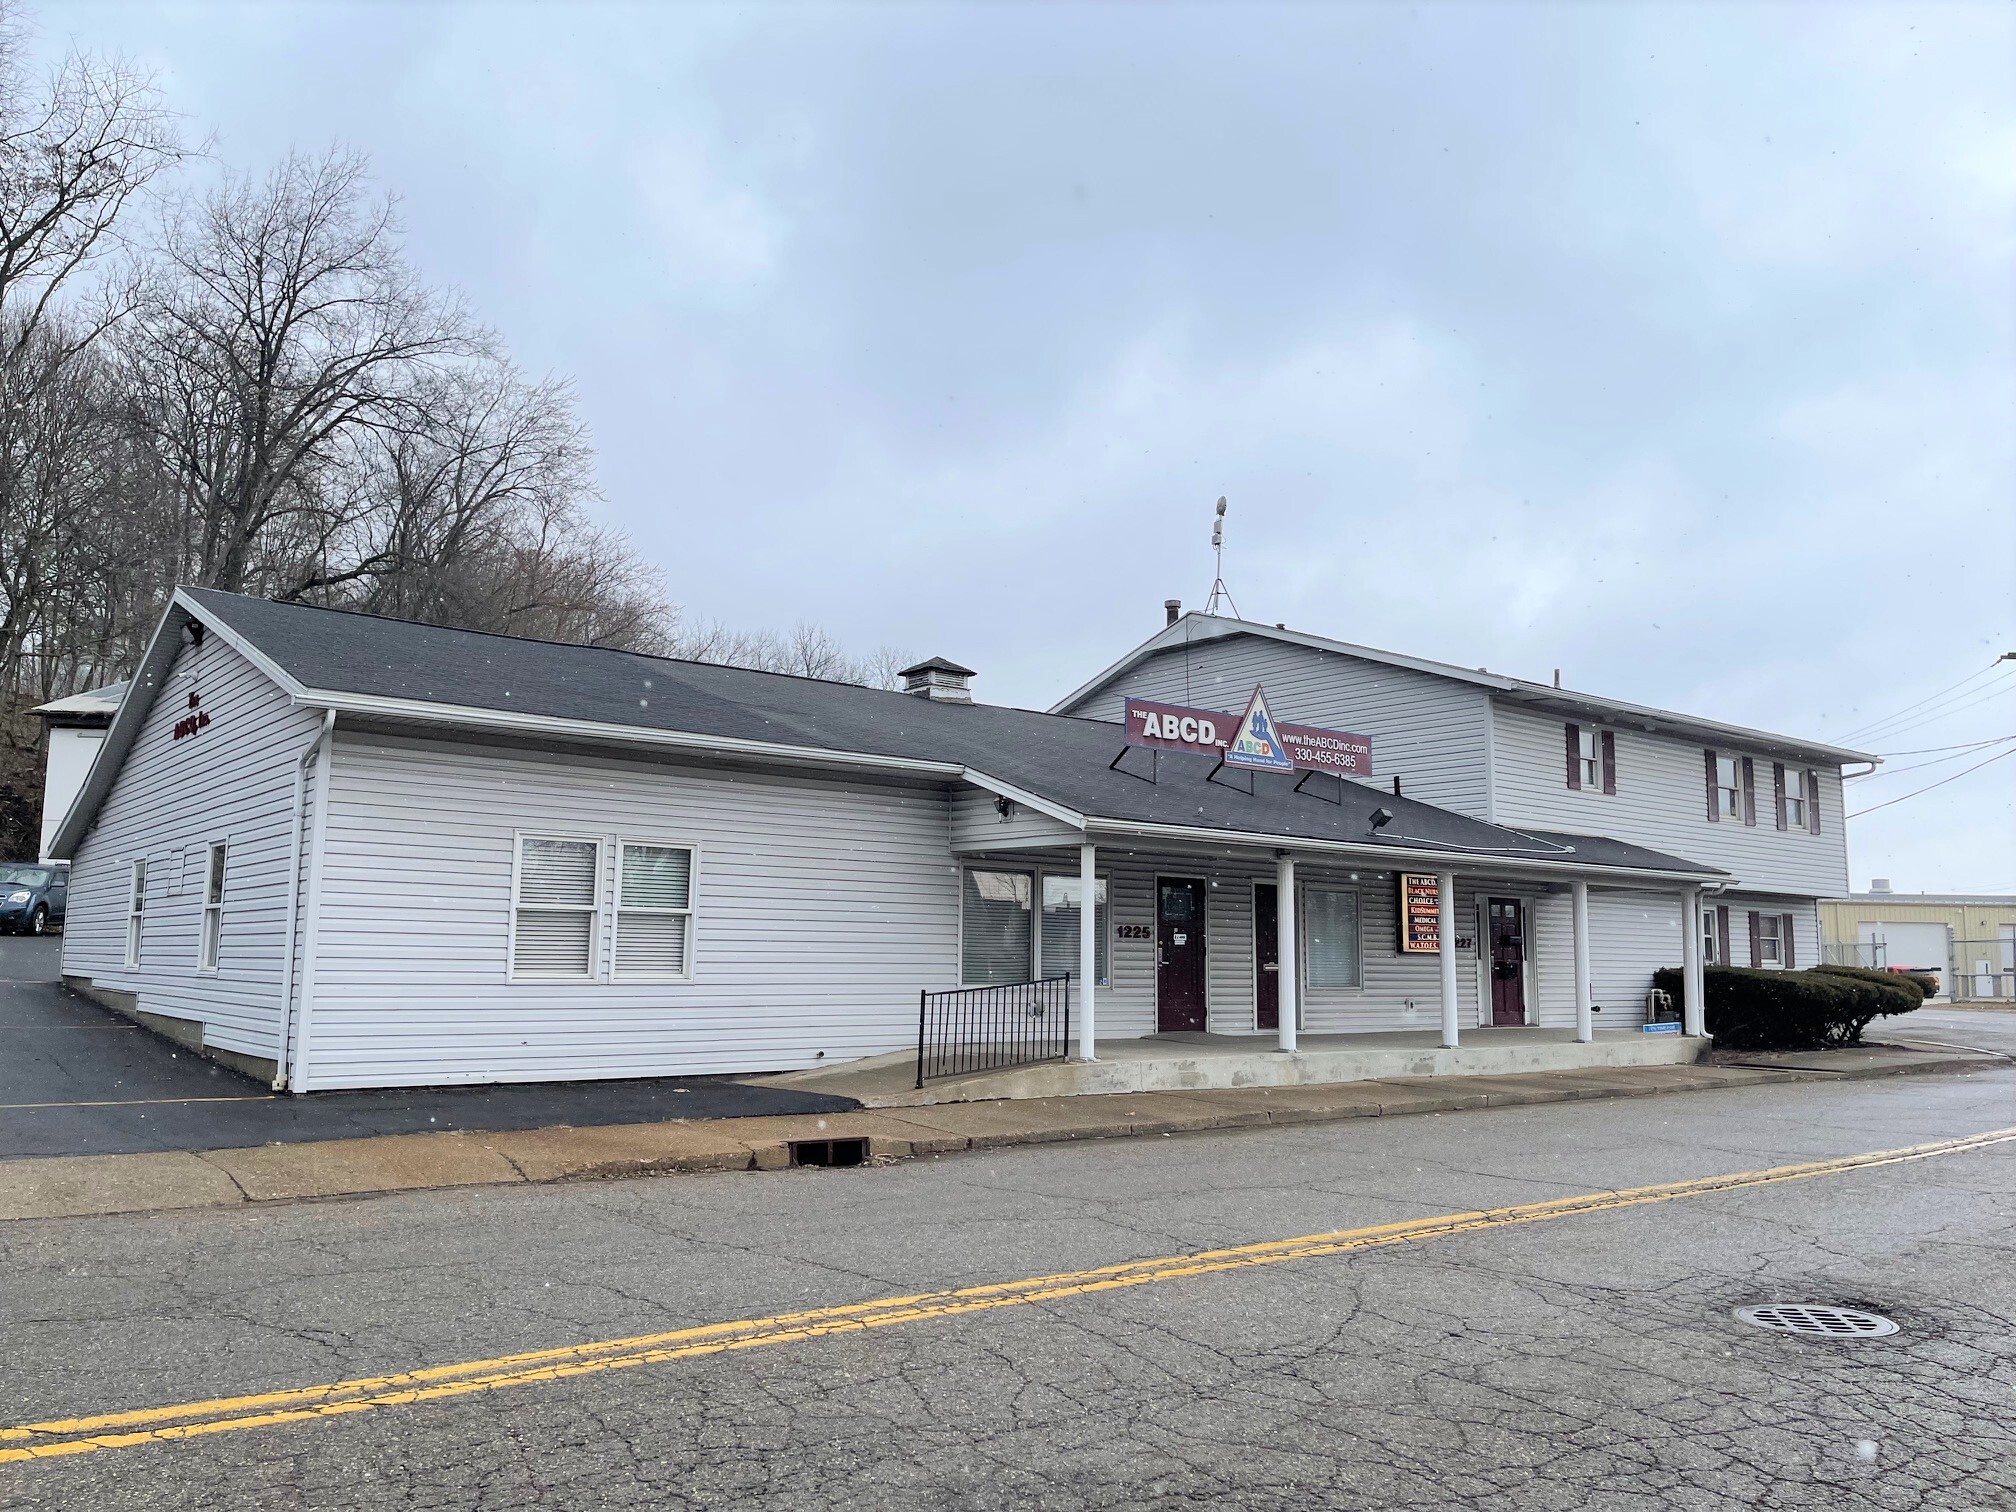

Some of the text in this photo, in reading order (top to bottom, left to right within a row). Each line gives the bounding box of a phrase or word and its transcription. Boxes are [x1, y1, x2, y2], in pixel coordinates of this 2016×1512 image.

[1132, 710, 1229, 748] THE ABCD INC.
[1238, 740, 1270, 755] ABCD
[1281, 734, 1368, 755] www.theABCDinc.com
[1294, 748, 1356, 767] 330-455-6385
[1408, 897, 1434, 905] CHOICE
[1117, 926, 1151, 938] 1225
[1455, 937, 1472, 948] 227
